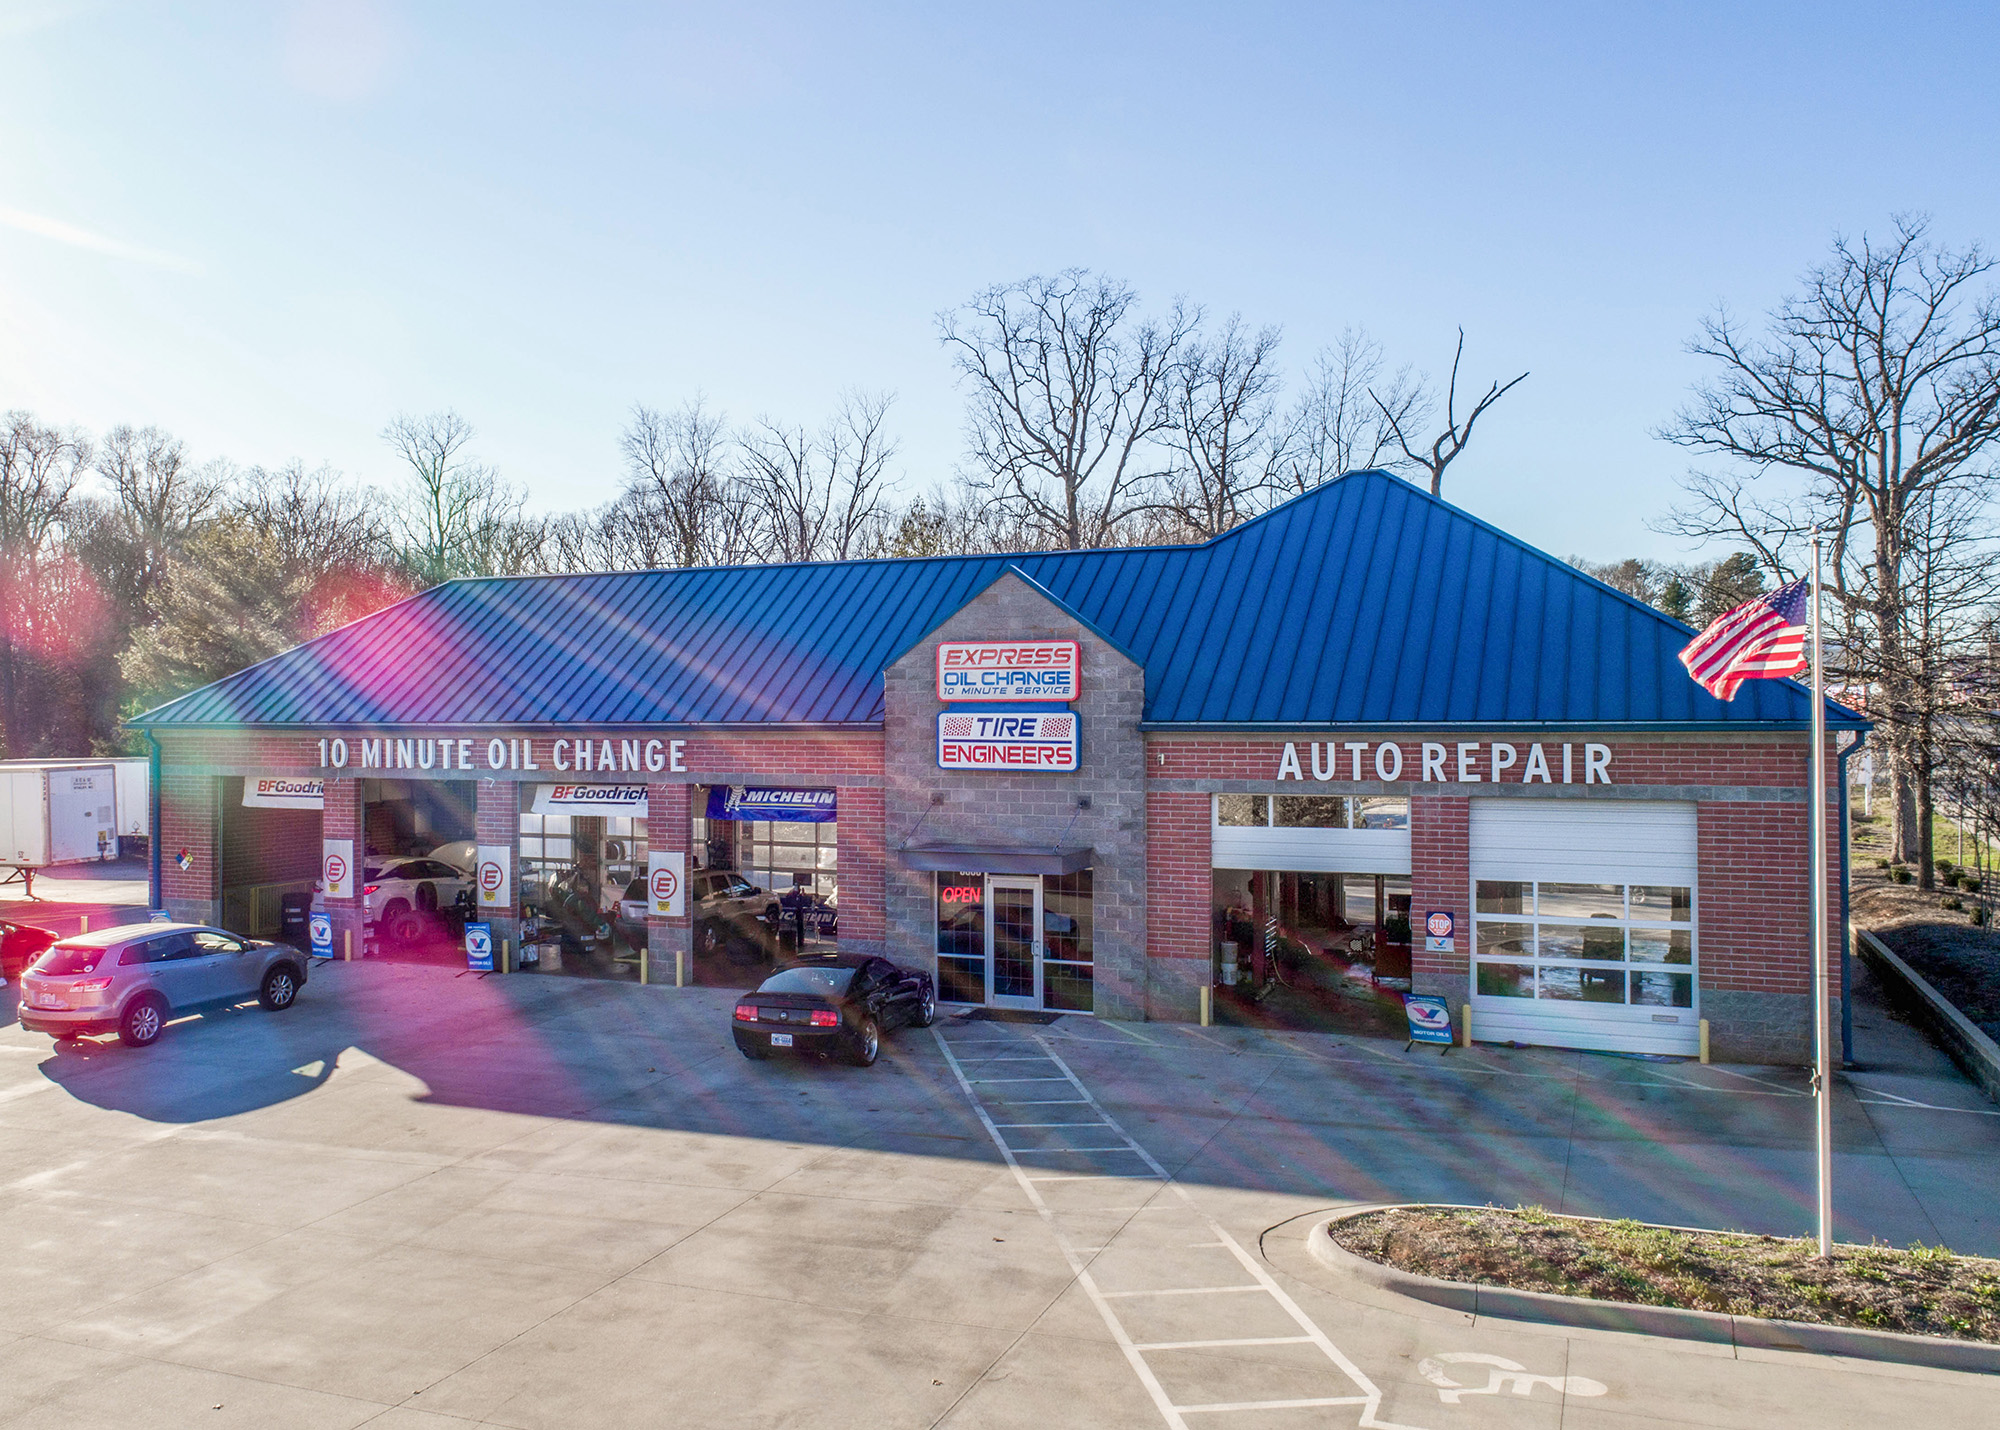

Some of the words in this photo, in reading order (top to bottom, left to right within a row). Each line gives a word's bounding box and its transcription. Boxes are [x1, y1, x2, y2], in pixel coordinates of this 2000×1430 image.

[944, 647, 1073, 665] EXPRESS
[944, 672, 977, 686] OIL
[981, 671, 1071, 686] CHANGE
[943, 687, 955, 695] 10
[961, 687, 1008, 695] MINUTE
[1015, 686, 1070, 695] SERVICE
[977, 717, 1037, 737] TIRE
[318, 738, 348, 768] 10
[362, 738, 475, 770] MINUTE
[488, 738, 539, 770] OIL
[553, 739, 688, 772] CHANGE
[943, 745, 1072, 765] ENGINEERS
[1277, 742, 1403, 782] AUTO
[1422, 742, 1613, 785] REPAIR
[551, 785, 648, 800] BFGoodrich
[746, 790, 835, 804] MICHELIN
[942, 887, 981, 903] OPEN
[1430, 919, 1450, 929] STOP
